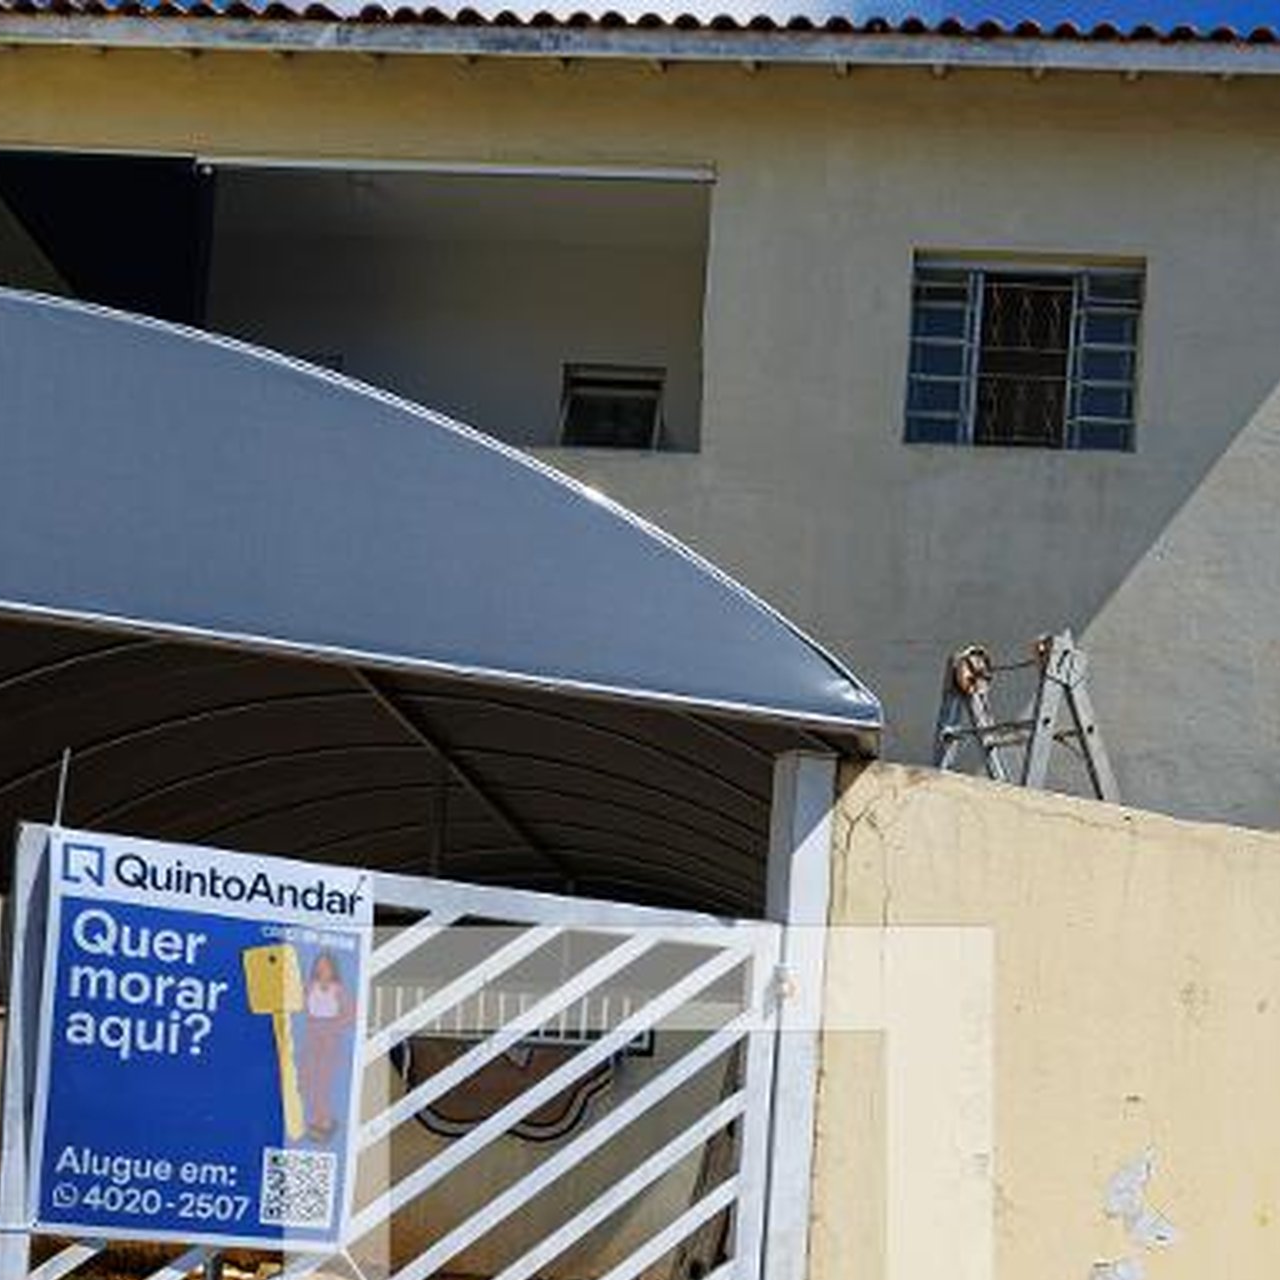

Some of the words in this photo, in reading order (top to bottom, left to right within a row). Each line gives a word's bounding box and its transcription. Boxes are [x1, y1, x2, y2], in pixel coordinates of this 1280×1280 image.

[114, 854, 363, 916] QuintoAndar
[73, 909, 207, 965] Quer
[69, 965, 229, 1012] morar
[66, 1010, 212, 1060] aqui?
[55, 1146, 172, 1185] Alugue
[179, 1162, 237, 1187] em:
